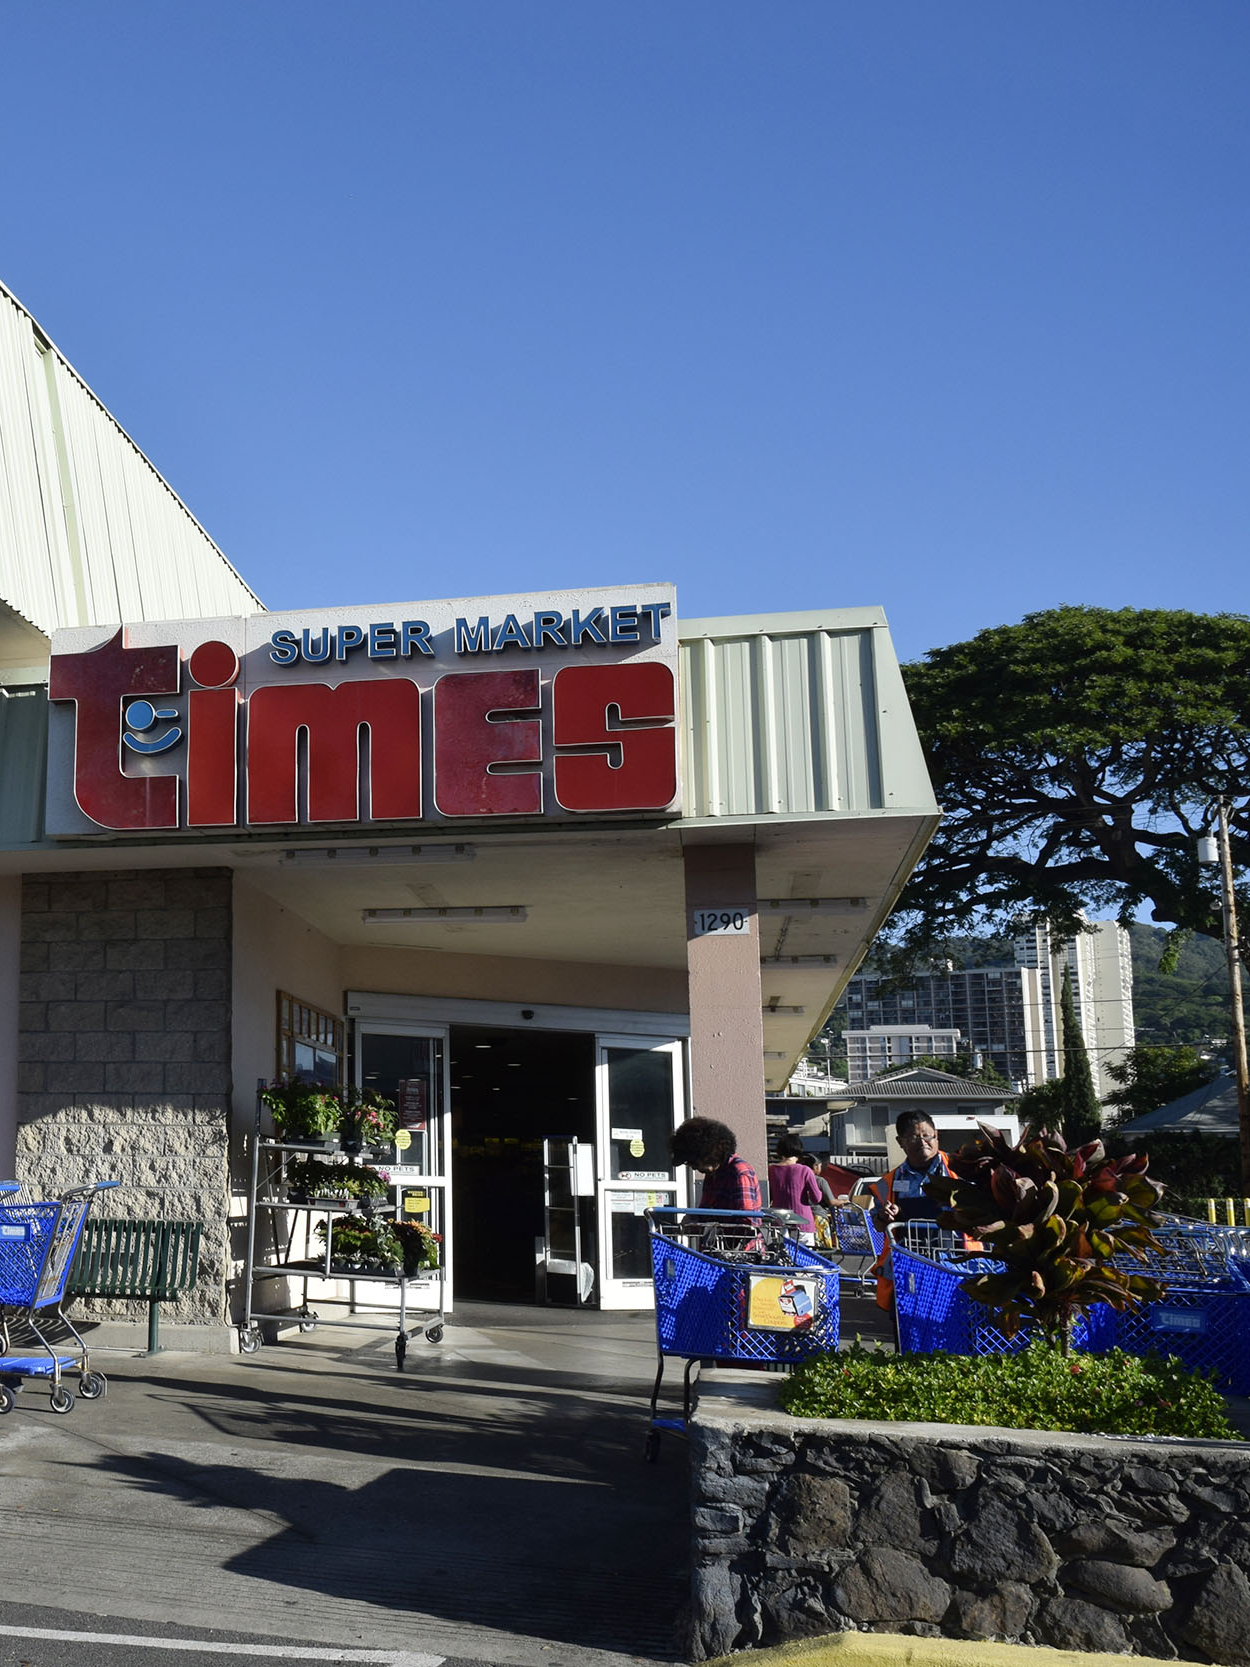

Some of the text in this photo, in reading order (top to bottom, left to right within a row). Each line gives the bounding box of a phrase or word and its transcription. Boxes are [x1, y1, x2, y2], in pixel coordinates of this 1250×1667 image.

[269, 602, 672, 665] SUPER MARKET
[700, 912, 744, 931] 1290
